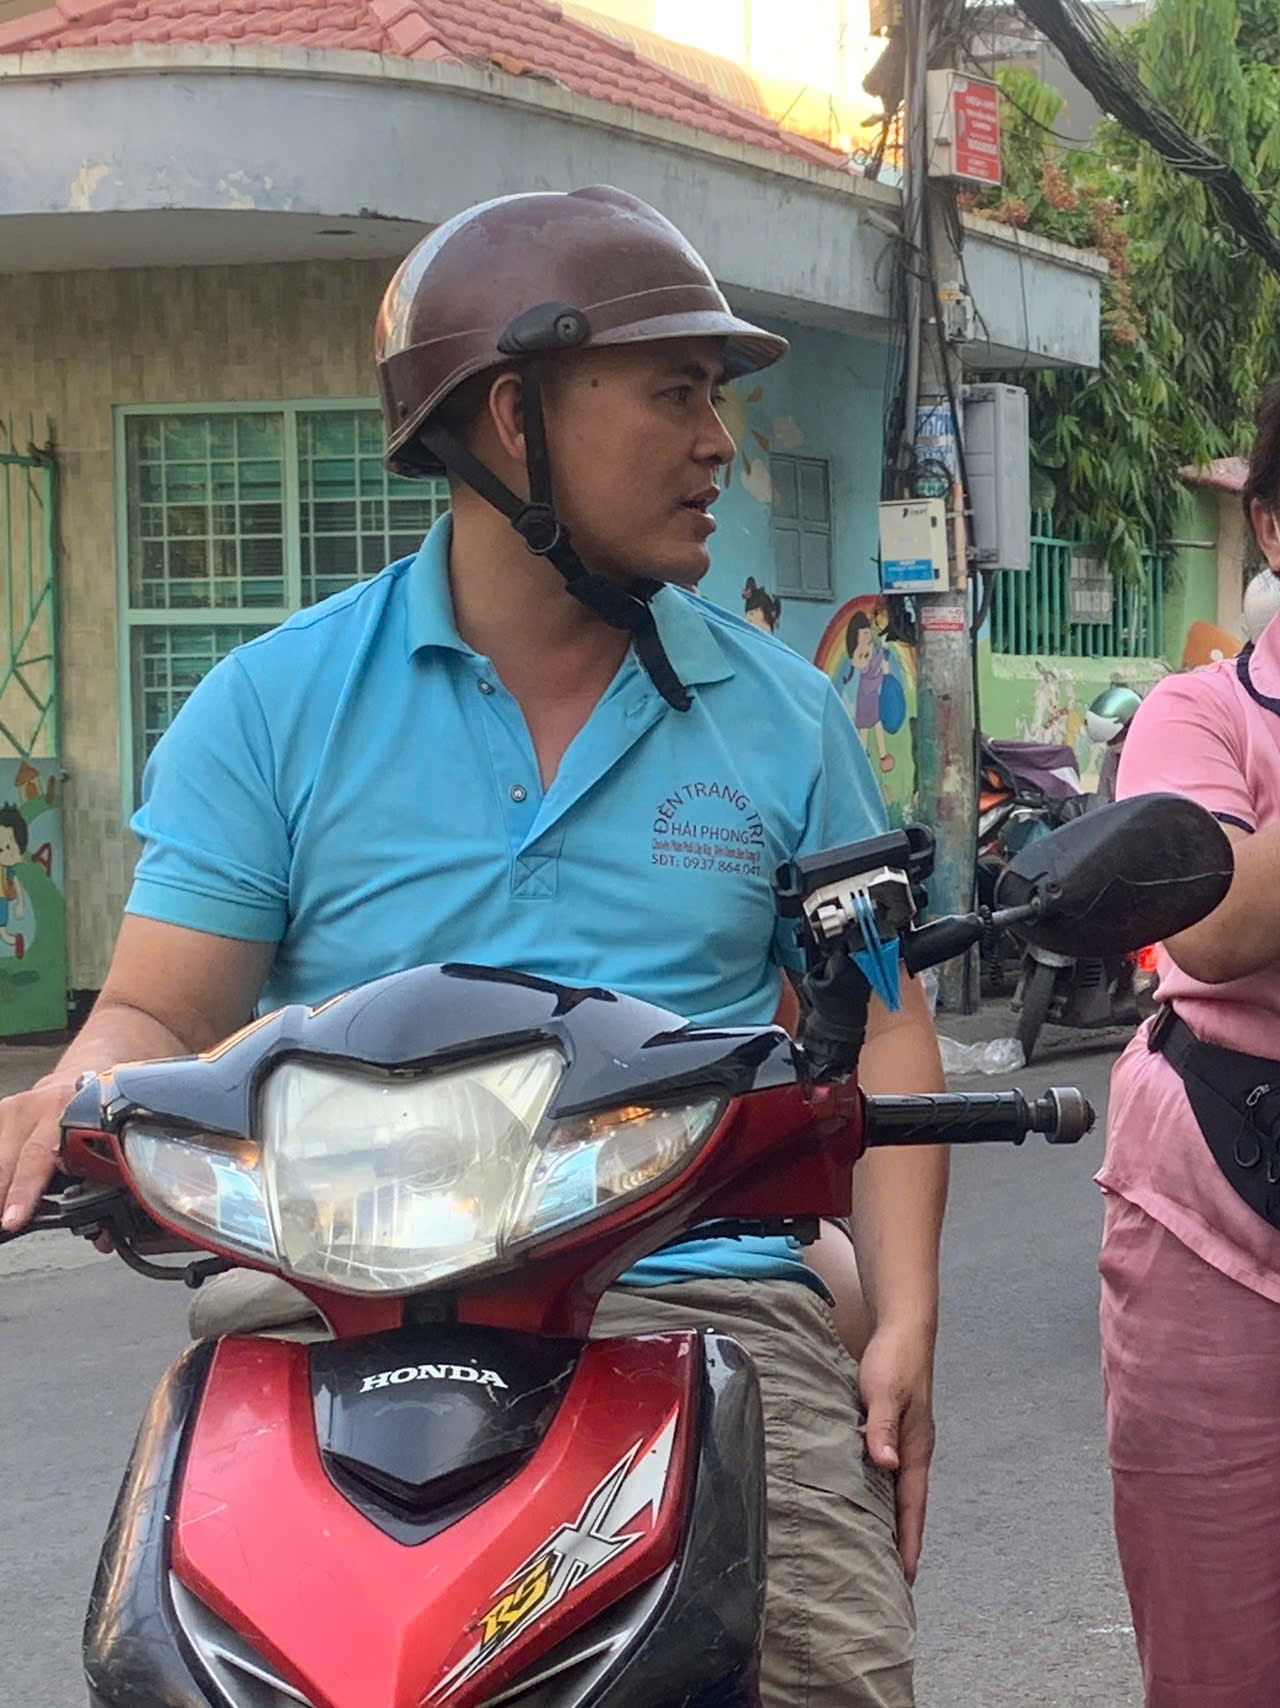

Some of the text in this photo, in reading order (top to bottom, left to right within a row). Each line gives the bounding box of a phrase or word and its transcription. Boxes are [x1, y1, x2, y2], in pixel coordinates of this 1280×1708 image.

[652, 791, 685, 834] ĐÈN
[681, 781, 751, 812] TRANG
[700, 824, 750, 845] PHONG
[359, 1364, 509, 1393] HONDA
